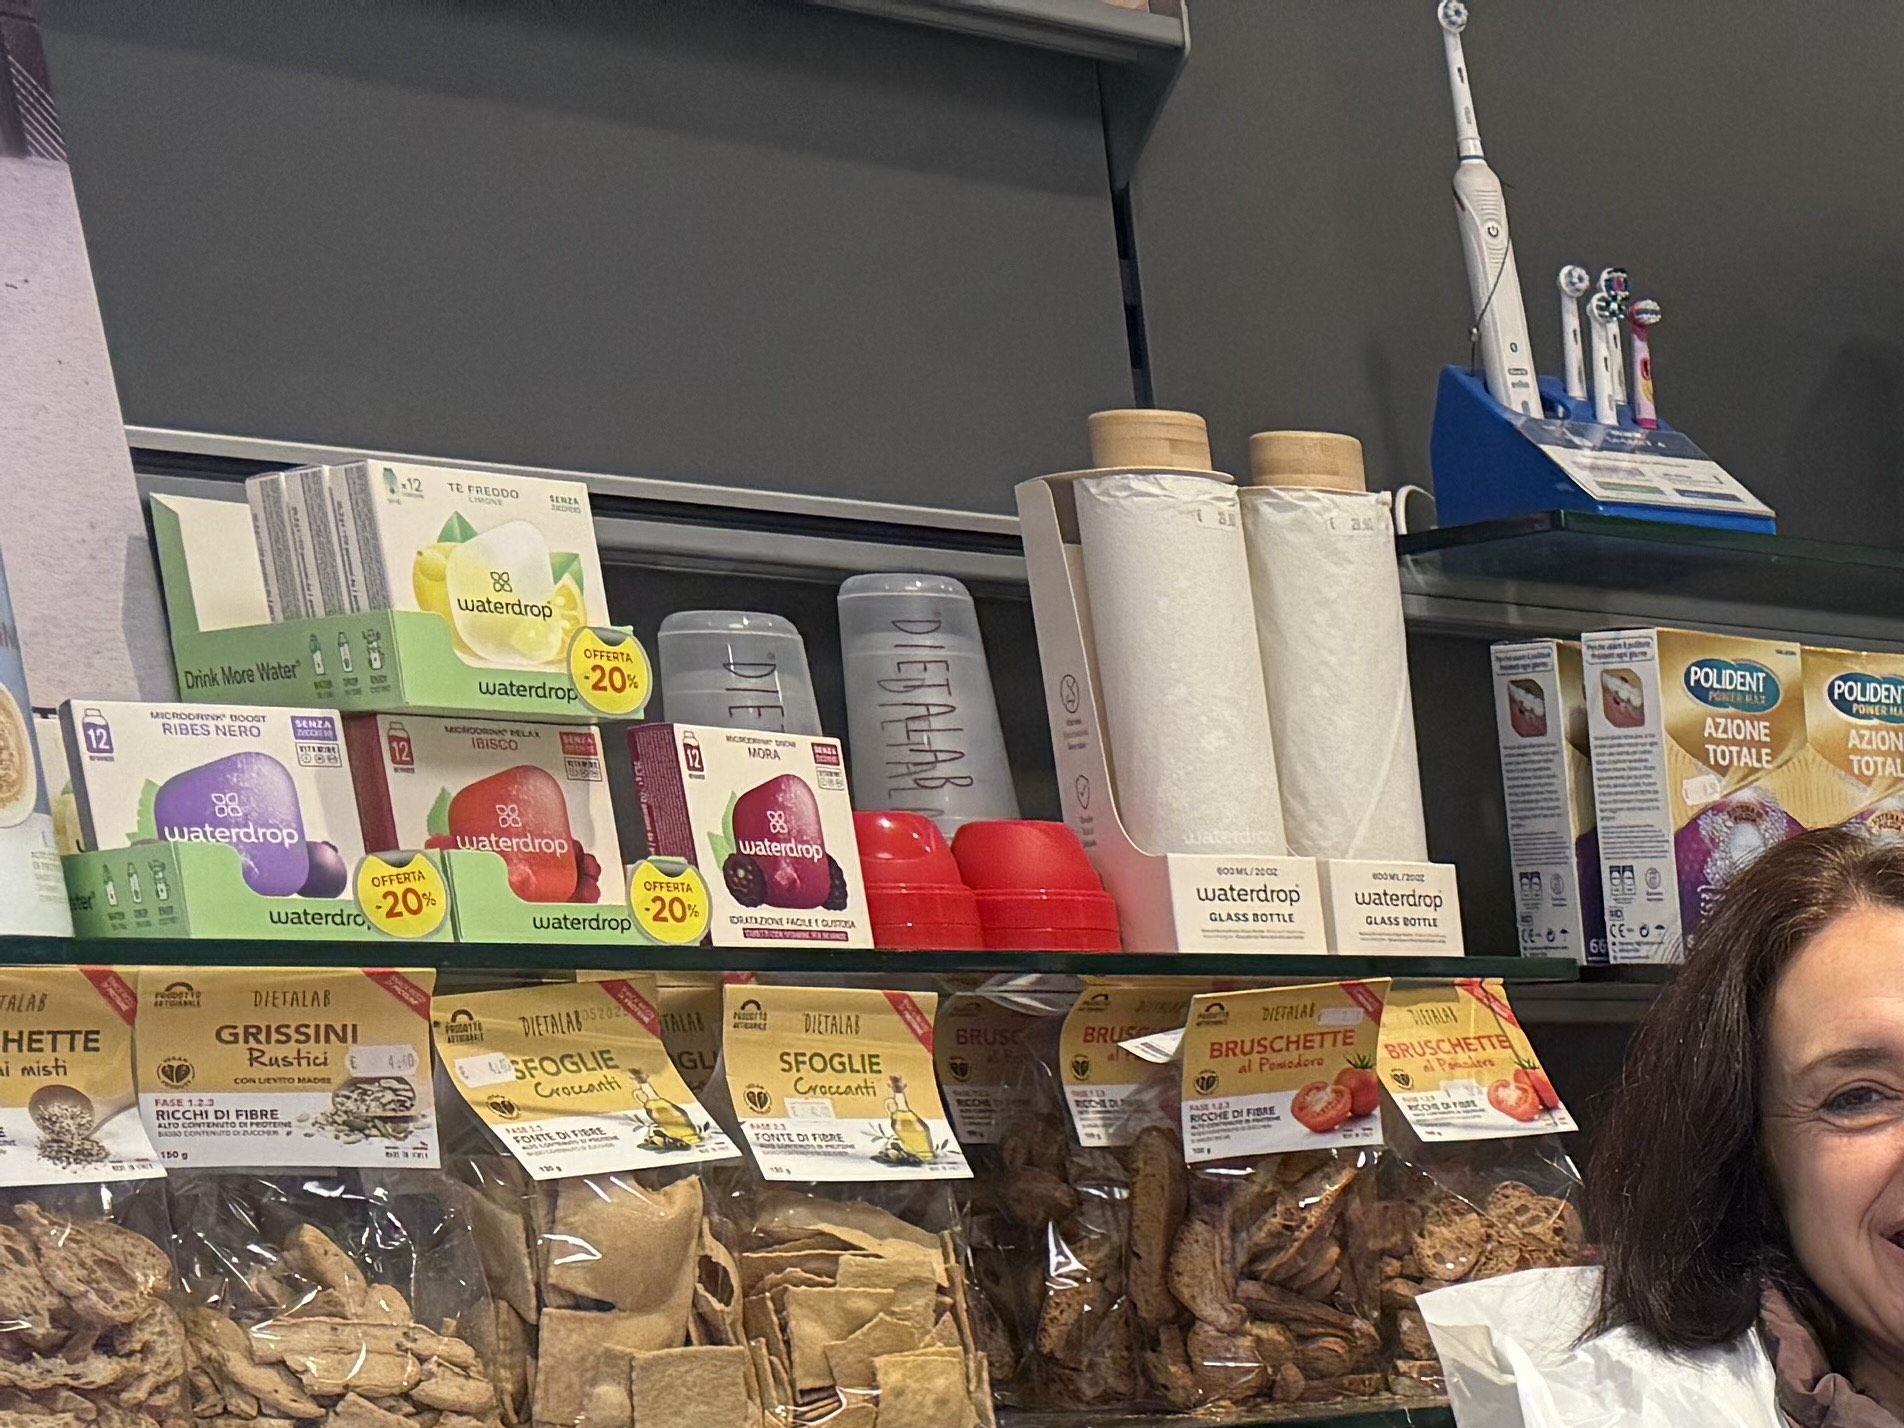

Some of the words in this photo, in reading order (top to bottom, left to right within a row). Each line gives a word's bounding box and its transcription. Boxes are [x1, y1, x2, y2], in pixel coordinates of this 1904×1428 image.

[457, 598, 553, 621] waterdrop
[583, 648, 634, 666] OFFERTA
[184, 662, 218, 689] Drink
[221, 662, 256, 686] More
[259, 659, 302, 683] Water
[1689, 667, 1767, 698] POLIDENT
[478, 678, 579, 703] waterdrop
[161, 721, 209, 735] RIBES
[214, 723, 262, 739] NERO
[1704, 717, 1771, 743] AZIONE
[1705, 743, 1772, 769] TOTALE
[1196, 883, 1300, 906] waterdrop
[1209, 911, 1248, 924] GLASS
[1252, 912, 1295, 924] BOTTLE
[253, 989, 331, 1010] DIETALAB
[215, 1022, 359, 1047] GRISSINI
[1208, 1028, 1356, 1060] BRUSCHETTE
[246, 1047, 329, 1069] Rustici
[514, 1049, 620, 1082] SFOGLIE
[1238, 1055, 1254, 1074] al
[1258, 1052, 1325, 1073] Pomodoro
[534, 1074, 622, 1097] Croccanti
